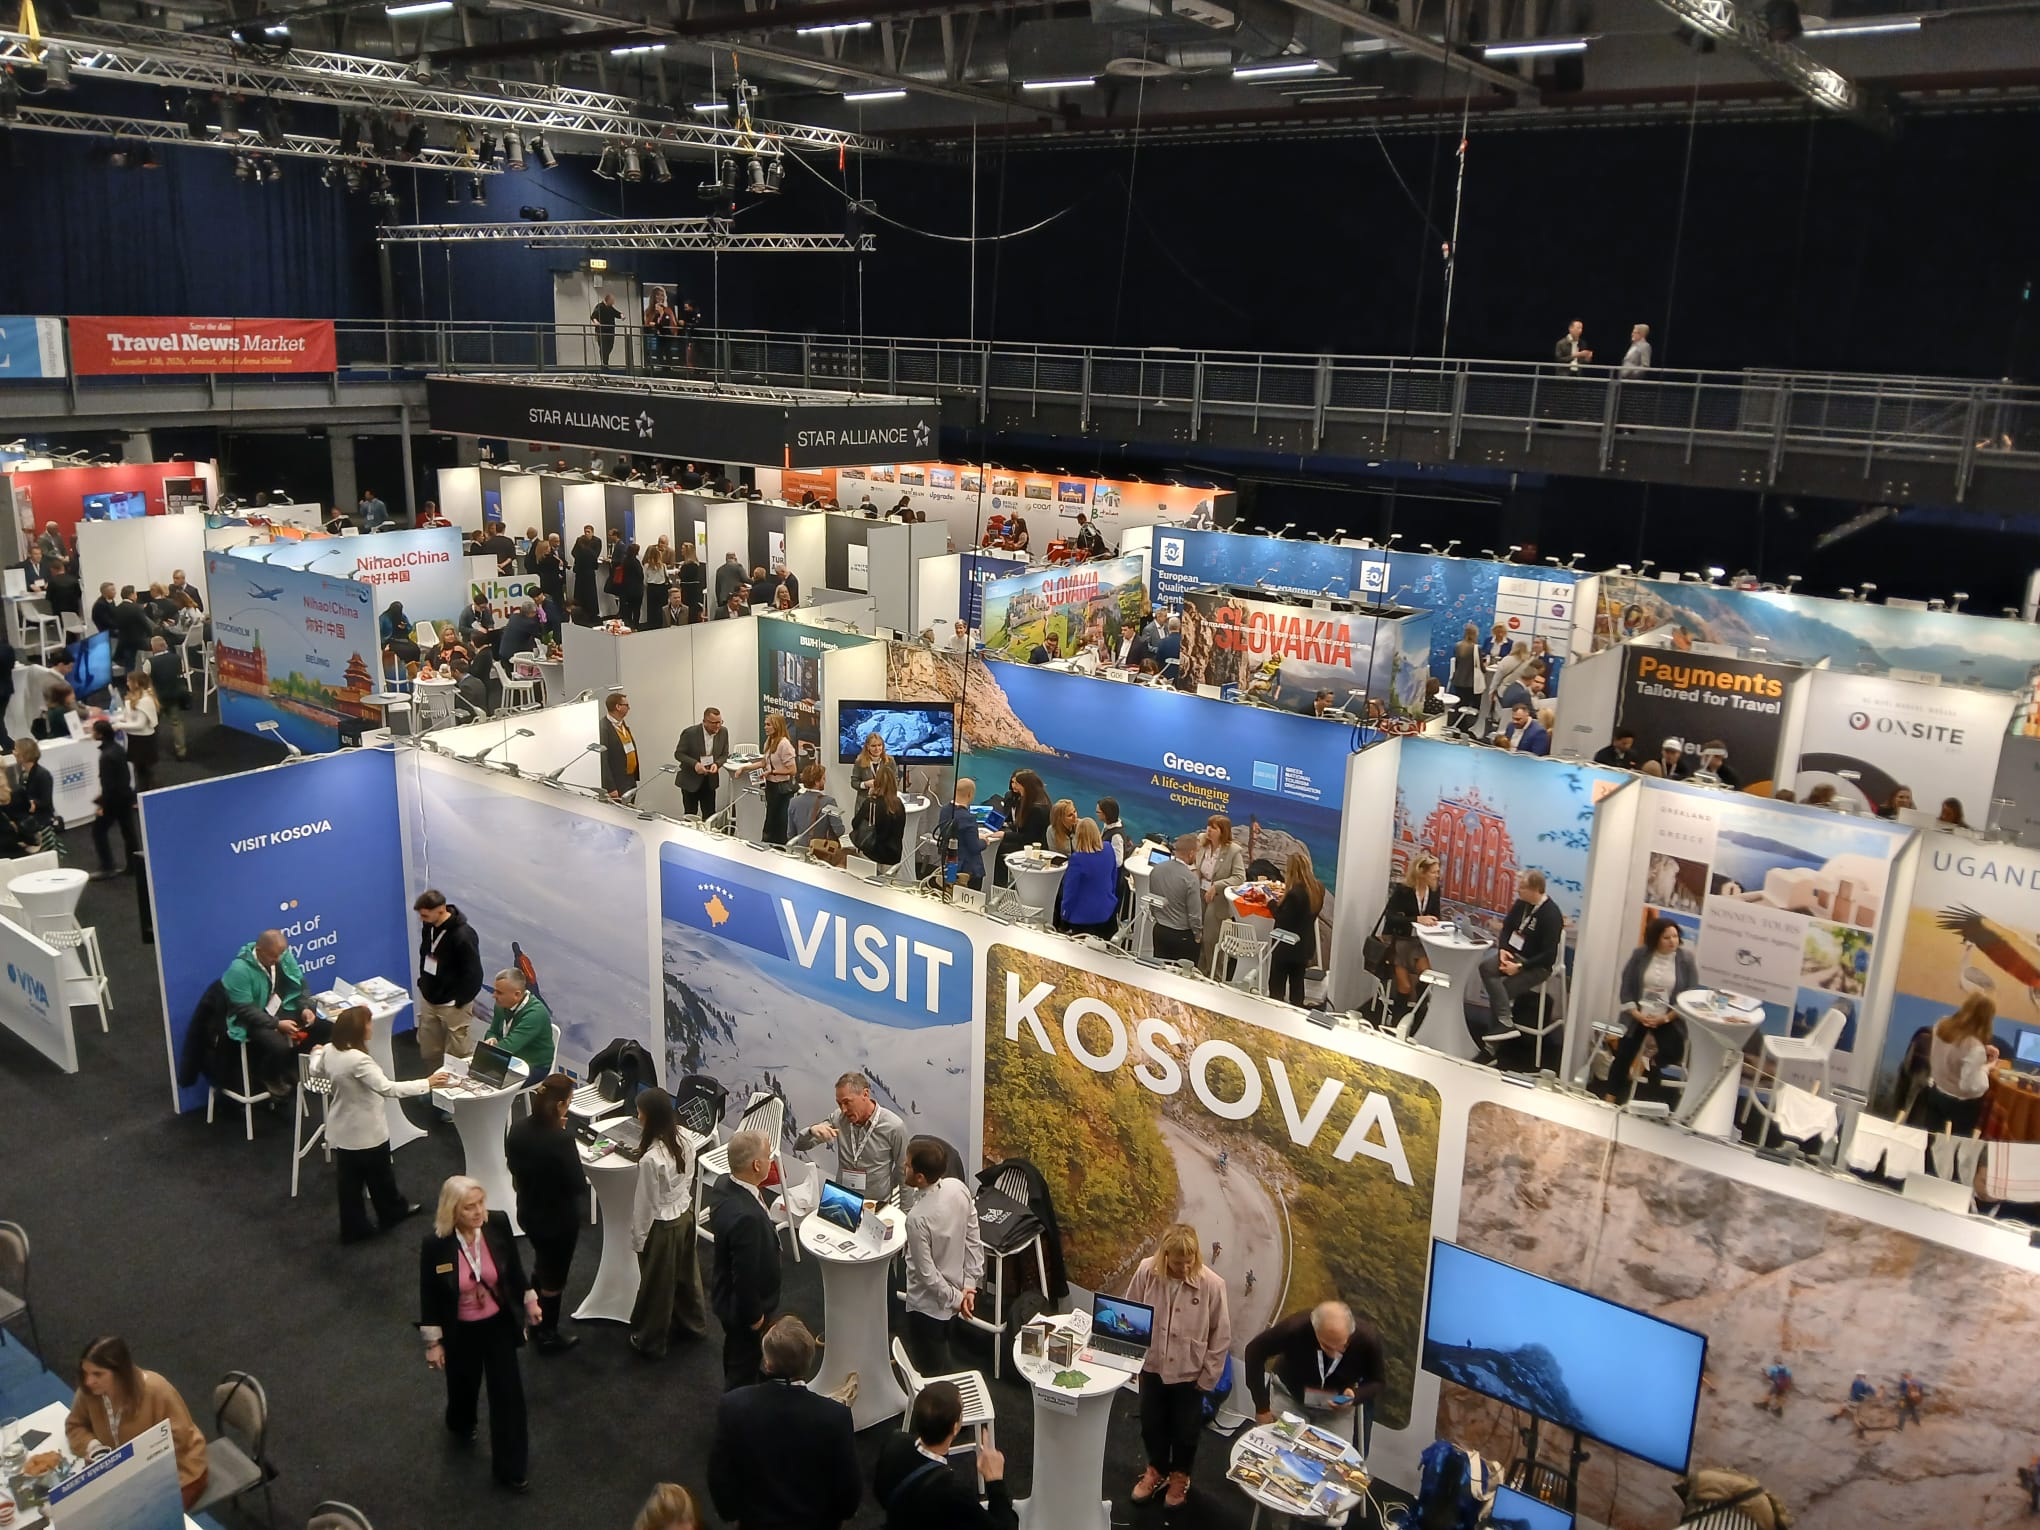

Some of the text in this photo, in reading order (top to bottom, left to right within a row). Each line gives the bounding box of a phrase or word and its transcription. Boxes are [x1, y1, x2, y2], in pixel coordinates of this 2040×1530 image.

[107, 333, 305, 352] Travel News Market
[529, 408, 630, 432] STAR ALLIANCE
[797, 427, 908, 447] STAR ALLIANCE
[357, 550, 450, 572] Nihao!China
[1158, 569, 1200, 584] European
[1158, 581, 1190, 594] Quality
[1041, 571, 1100, 607] SLOVAKIA
[303, 595, 359, 619] Nihao!China
[215, 621, 250, 637] STOCKHOLM
[305, 616, 346, 640] 你好!中国
[1214, 606, 1352, 668] SLOVAKIA
[799, 635, 819, 648] BWH
[305, 654, 330, 668] BEIJING
[1638, 655, 1783, 698] Payments
[763, 694, 816, 714] Meetings that
[1635, 680, 1782, 715] Tailored for Travel
[763, 705, 800, 720] stand out
[1876, 716, 1966, 746] ONSITE
[1163, 751, 1231, 781] Greece.
[1150, 773, 1160, 786] A
[1162, 775, 1231, 804] life-changing
[1169, 791, 1230, 814] experience.
[230, 819, 332, 854] VISIT KOSOVA
[280, 914, 321, 938] nd of
[289, 930, 338, 959] ty and
[780, 897, 953, 1014] VISIT
[298, 954, 336, 975] nture
[16, 966, 50, 1008] VIVA
[1004, 970, 1415, 1187] KOSOVA
[160, 1425, 168, 1437] 5
[61, 1475, 86, 1494] MEET
[86, 1451, 123, 1478] SWEDEN
